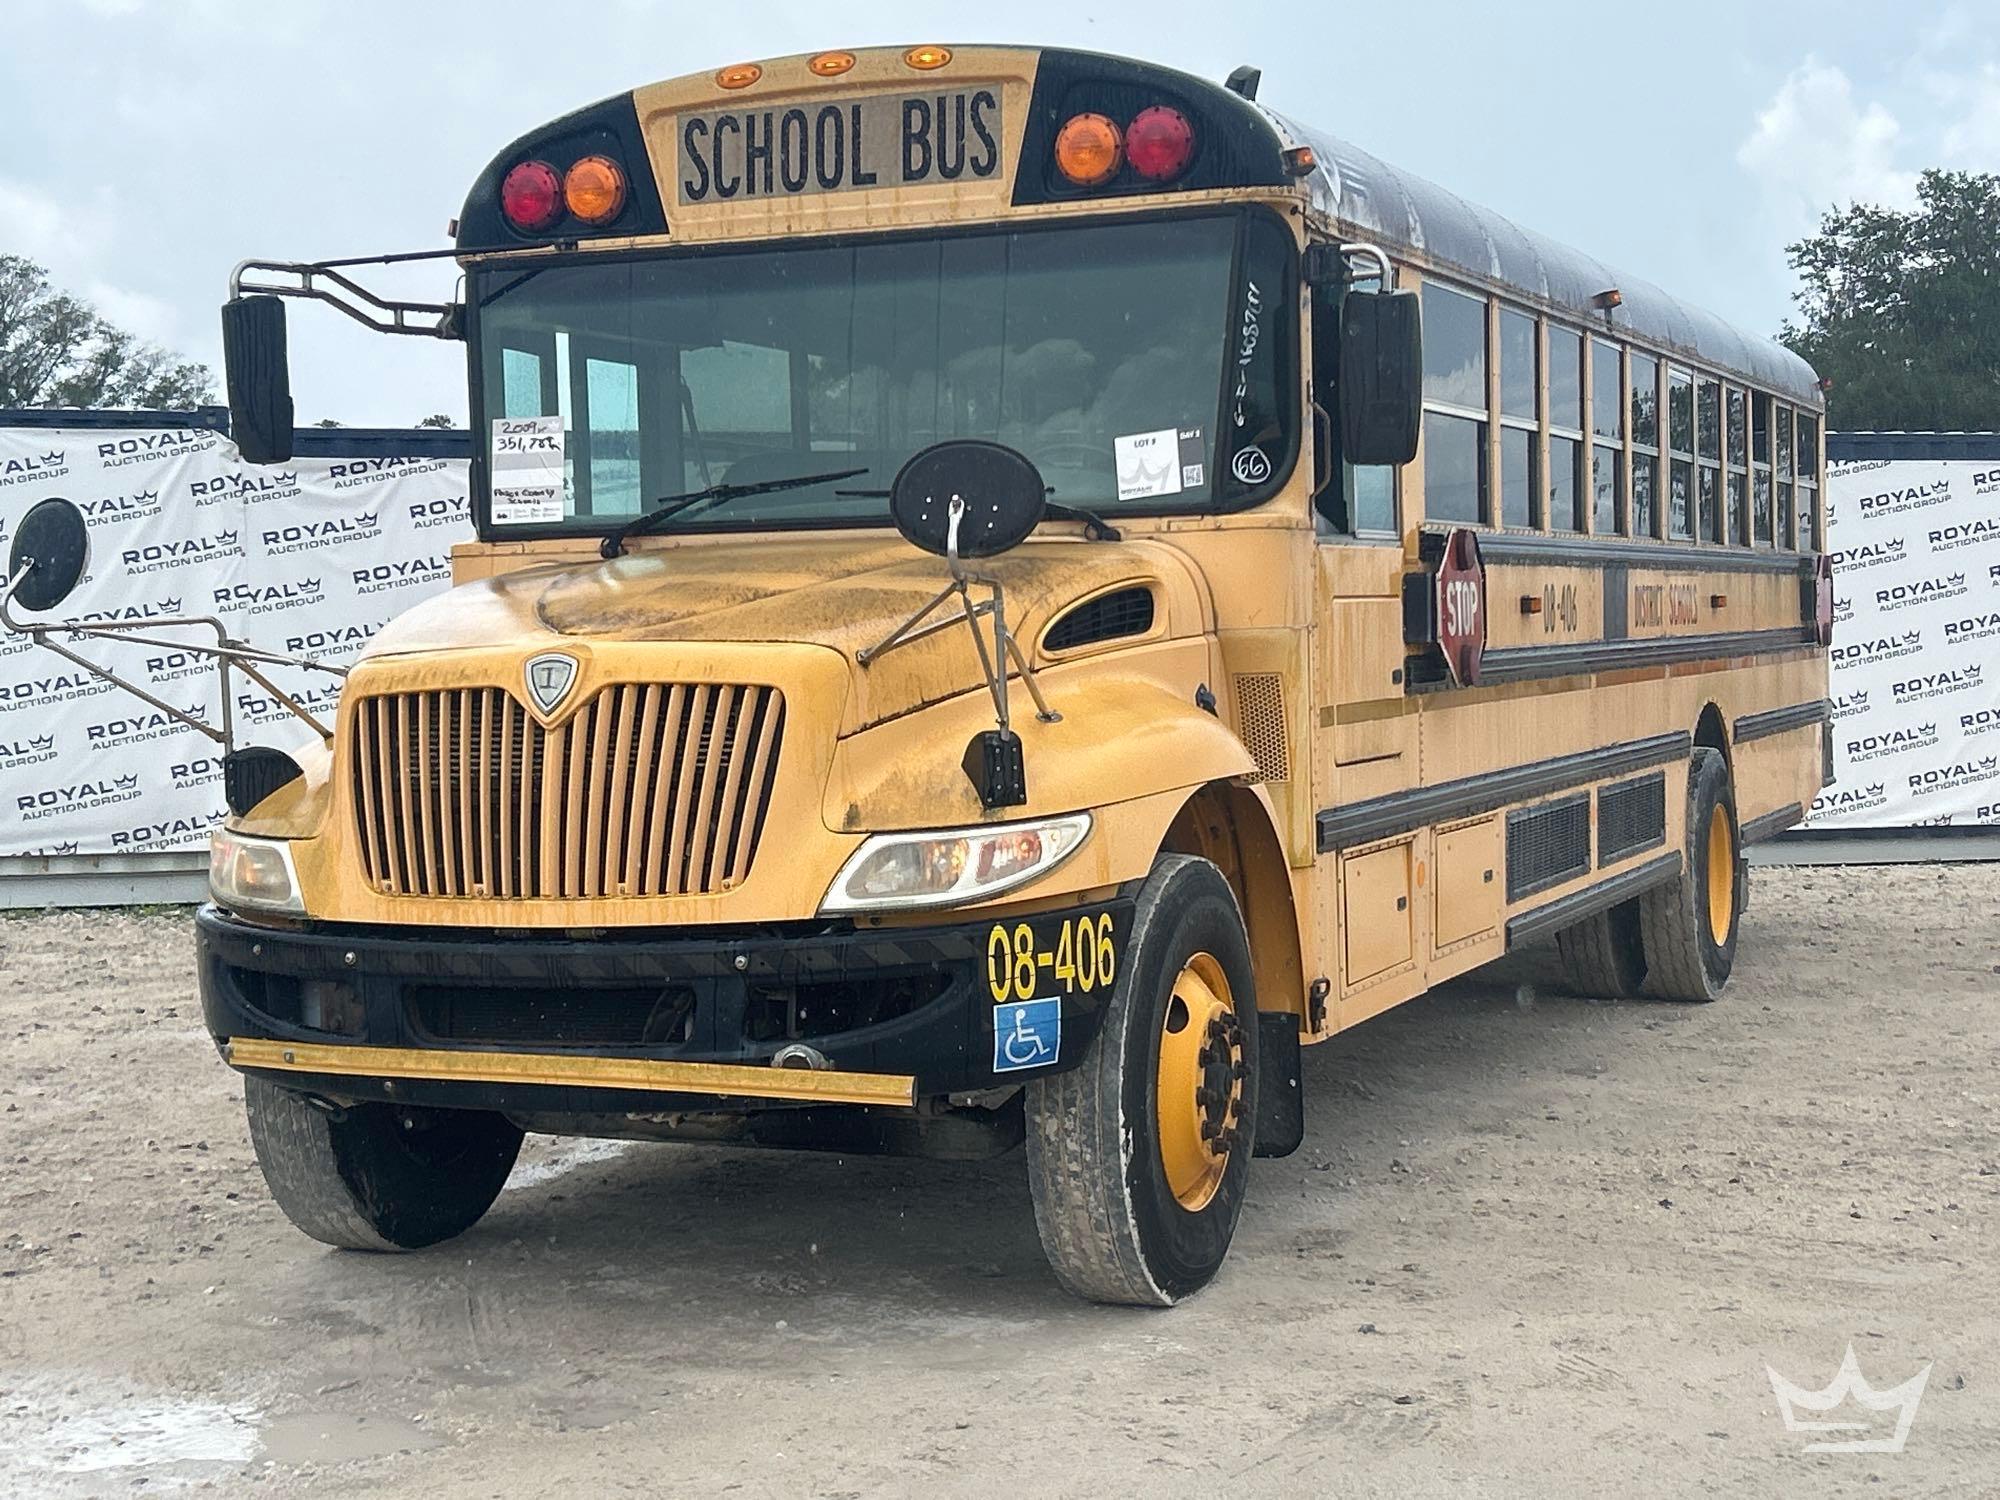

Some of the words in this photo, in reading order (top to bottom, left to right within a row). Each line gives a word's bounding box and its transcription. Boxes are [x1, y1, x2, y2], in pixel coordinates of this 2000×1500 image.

[684, 103, 877, 201] SCHOOL
[902, 91, 997, 182] BUS
[98, 430, 193, 458] ROYAL
[103, 451, 168, 468] AUCTION
[170, 440, 217, 456] GROUP
[1134, 439, 1149, 448] LOT
[17, 468, 69, 483] GROUP
[334, 471, 396, 489] AUCTION
[399, 462, 448, 477] GROUP
[1238, 453, 1264, 478] 66
[190, 473, 274, 497] ROYAL
[252, 488, 301, 503] GROUP
[79, 496, 134, 515] YAL
[409, 497, 471, 518] ROY
[1860, 486, 1931, 510] ROYAL
[1863, 504, 1912, 519] AUCTION
[1913, 494, 1951, 509] GROUP
[111, 507, 162, 523] GROUP
[262, 518, 355, 545] ROYAL
[267, 539, 330, 556] AUCTION
[332, 529, 382, 545] GROUP
[1928, 518, 1999, 543] ROYAL
[1931, 536, 1981, 553] AUCTION
[1982, 531, 2000, 542] GRO
[122, 538, 216, 565] ROYAL
[127, 558, 191, 576] AUCTION
[194, 546, 243, 563] GROUP
[1831, 544, 1886, 564] OYAL
[1833, 558, 1866, 575] CTION
[1868, 552, 1907, 567] GROUP
[353, 557, 444, 584] ROYAL
[357, 576, 420, 595] AUCTION
[422, 570, 452, 583] GRO
[1876, 578, 1948, 603] ROYAL
[1879, 596, 1927, 612] AUCTION
[1929, 586, 1968, 601] GROUP
[218, 601, 272, 615] AUCION
[275, 594, 325, 610] GROUP
[1447, 581, 1478, 637] STOP
[1543, 583, 1578, 633] 08-406
[1944, 613, 2000, 636] ROYA
[1948, 629, 1995, 645] AUCTION
[0, 643, 34, 656] OUP
[286, 624, 375, 652] ROYAL
[1831, 636, 1902, 661] ROYAL
[146, 652, 213, 672] ROY
[1834, 654, 1883, 671] AUCTION
[1885, 645, 1923, 659] GROUP
[151, 664, 215, 683] AUCTION
[1892, 671, 1963, 696] ROYAL
[0, 673, 90, 700] ROYAL
[0, 694, 63, 712] AUCTION
[66, 683, 117, 700] GROUP
[1895, 688, 1944, 704] AUCTION
[1946, 679, 1984, 693] GROUP
[1832, 705, 1871, 720] GROUP
[1960, 709, 2000, 727] ROY
[92, 730, 157, 751] AUCTION
[1847, 728, 1919, 754] ROYAL
[1963, 722, 2000, 736] AUCTIO
[5, 751, 58, 769] GROUP
[1850, 747, 1899, 763] AUCTION
[1901, 737, 1939, 752] GROUP
[170, 757, 225, 779] ROY
[1909, 762, 1979, 787] ROYAL
[175, 772, 225, 790] AUCTIO
[1911, 780, 1960, 797] AUCTION
[1962, 771, 2000, 784] GROUP
[17, 781, 114, 811] ROYAL
[22, 800, 89, 821] AUCTION
[90, 790, 142, 807] GROUP
[1811, 789, 1866, 810] OYAL
[1850, 797, 1887, 812] GROUP
[111, 816, 207, 847] ROYAL
[116, 836, 181, 854] AUCTION
[183, 830, 216, 843] GRO
[987, 912, 1115, 1003] 08-406
